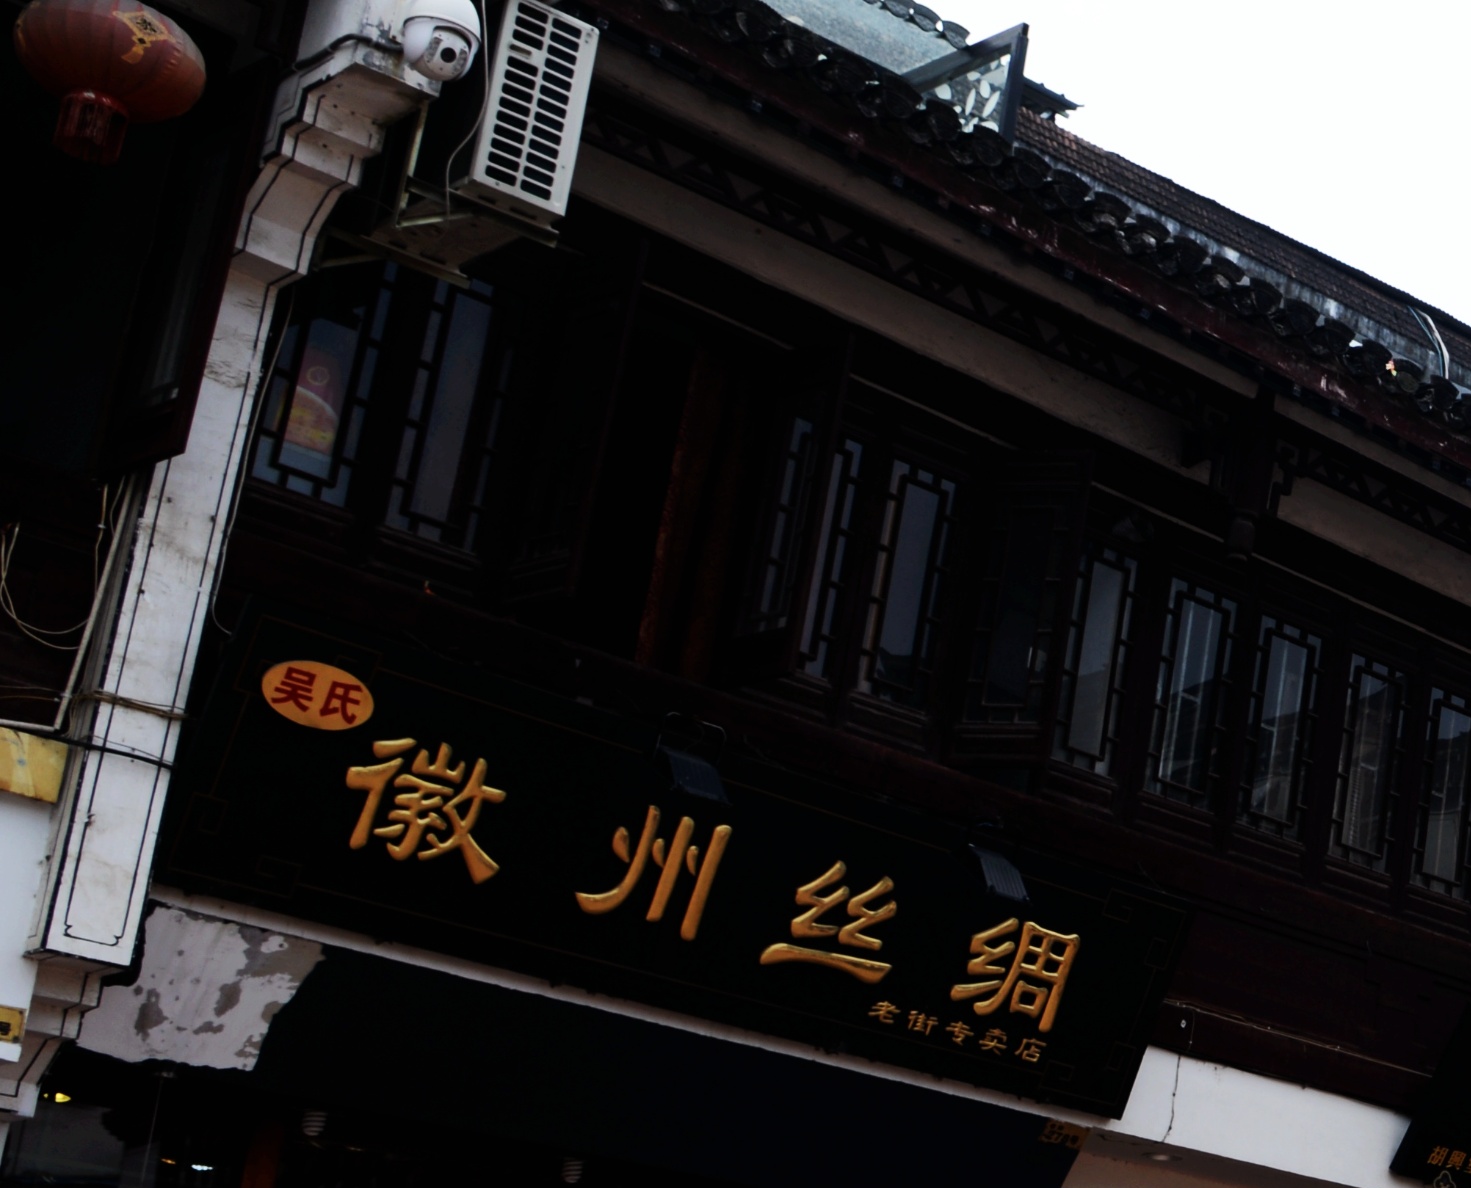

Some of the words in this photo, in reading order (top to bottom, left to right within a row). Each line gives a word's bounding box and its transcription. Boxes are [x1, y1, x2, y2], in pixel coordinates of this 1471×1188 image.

[272, 663, 365, 727] 吴氏
[345, 736, 1084, 1034] 徽州丝绸
[868, 999, 1049, 1065] 老街专卖店
